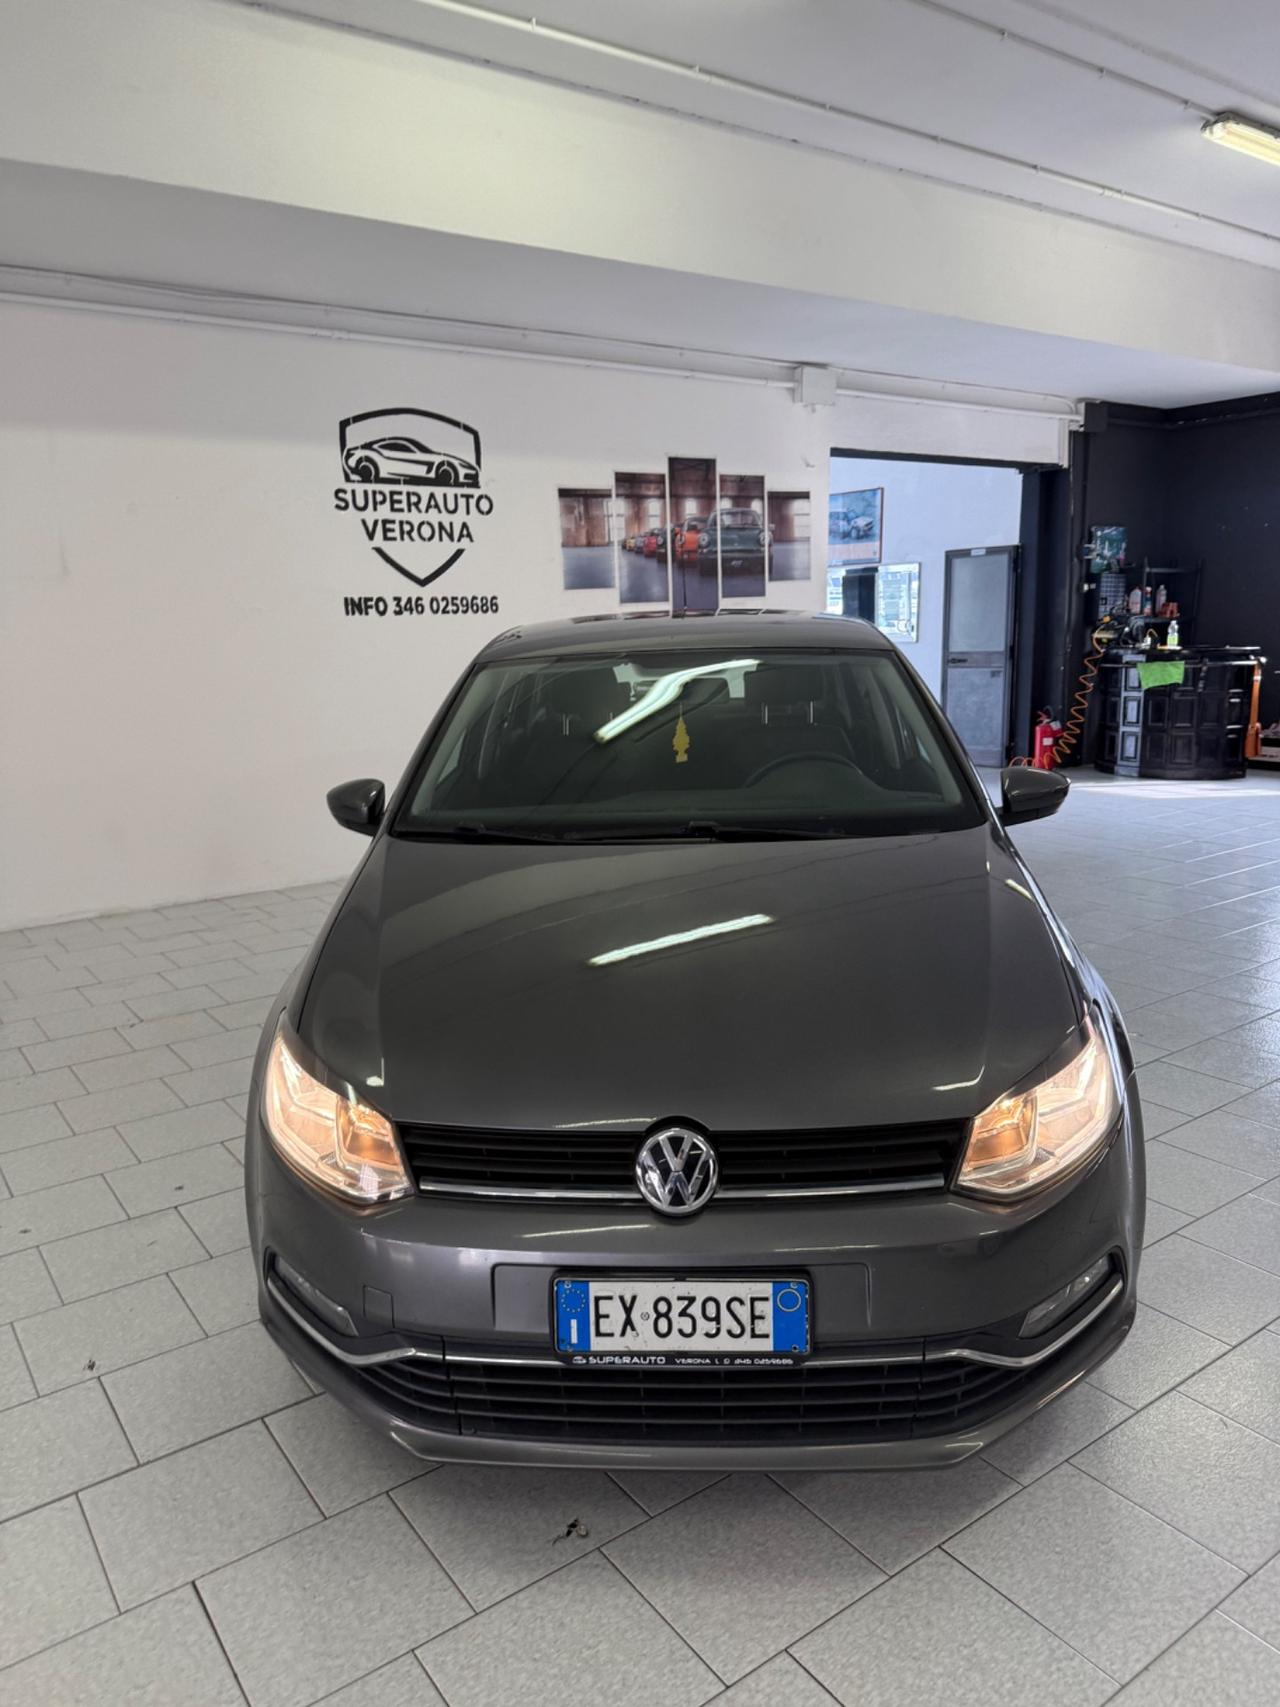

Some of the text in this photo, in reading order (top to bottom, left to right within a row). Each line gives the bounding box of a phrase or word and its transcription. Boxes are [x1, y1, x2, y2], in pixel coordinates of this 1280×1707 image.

[334, 488, 493, 516] SUPERAUTO
[360, 518, 474, 543] VERONA
[343, 596, 499, 616] INFO 346 0259686
[594, 1294, 771, 1339] EX 839SE
[588, 1355, 667, 1365] SUPERAUTO
